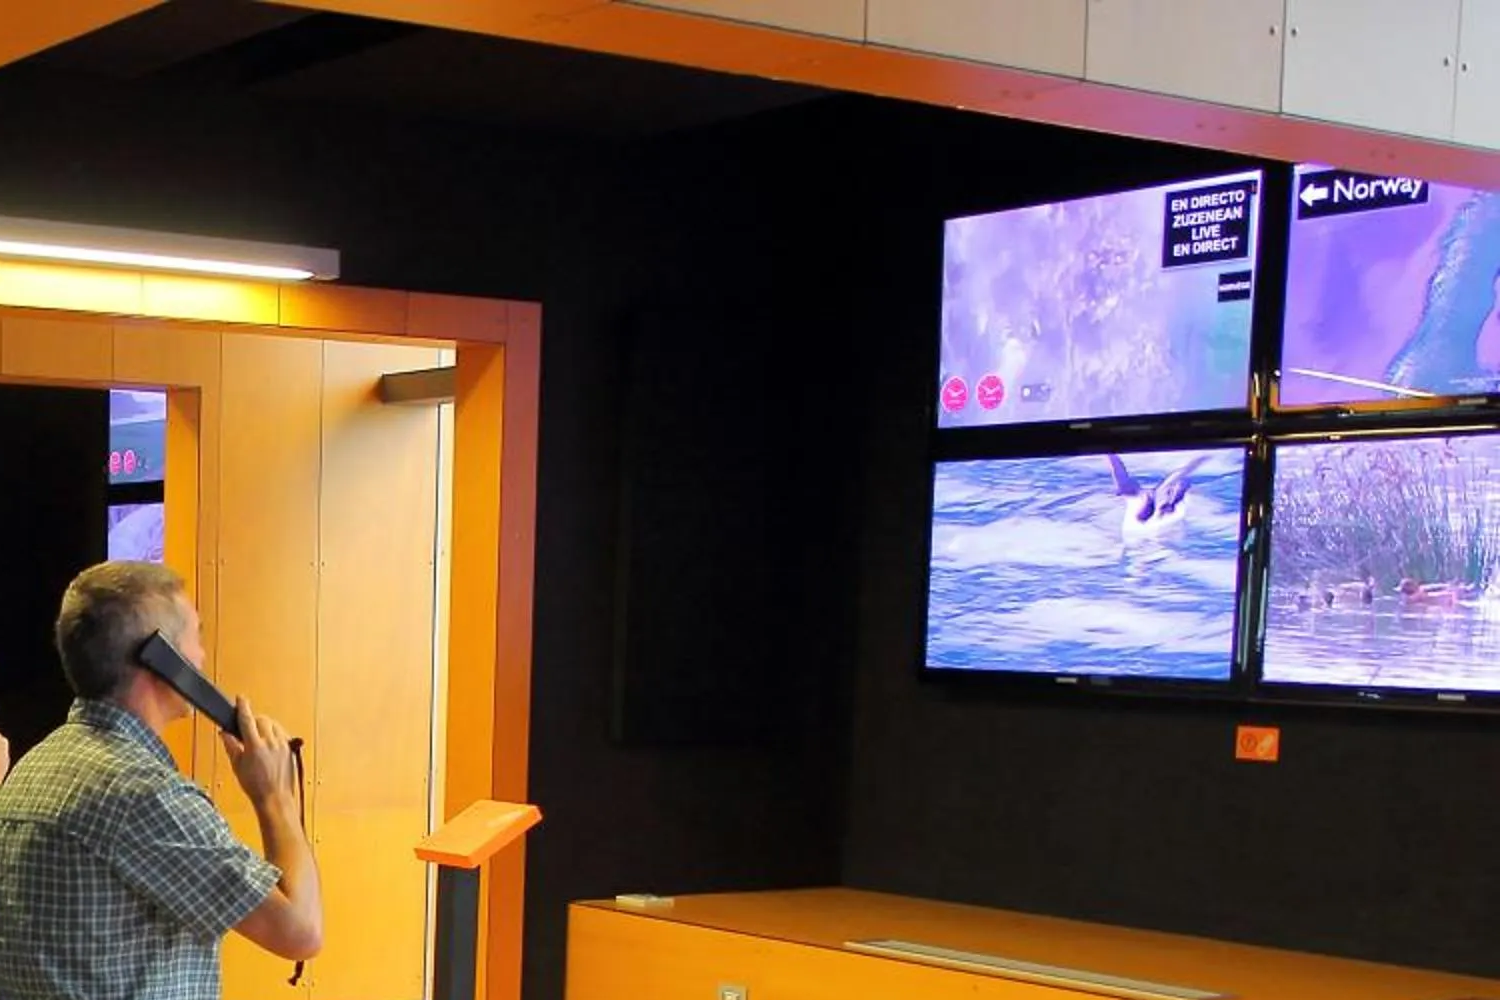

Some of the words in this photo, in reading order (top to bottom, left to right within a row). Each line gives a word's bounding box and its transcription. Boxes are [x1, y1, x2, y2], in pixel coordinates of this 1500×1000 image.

[1171, 198, 1188, 213] EN
[1191, 189, 1245, 209] DIRECTO
[1333, 177, 1423, 203] Norway
[1172, 205, 1243, 228] ZUZENEAN
[1191, 224, 1221, 241] LIVE
[1173, 243, 1190, 257] EN
[1193, 236, 1239, 255] DIRECT
